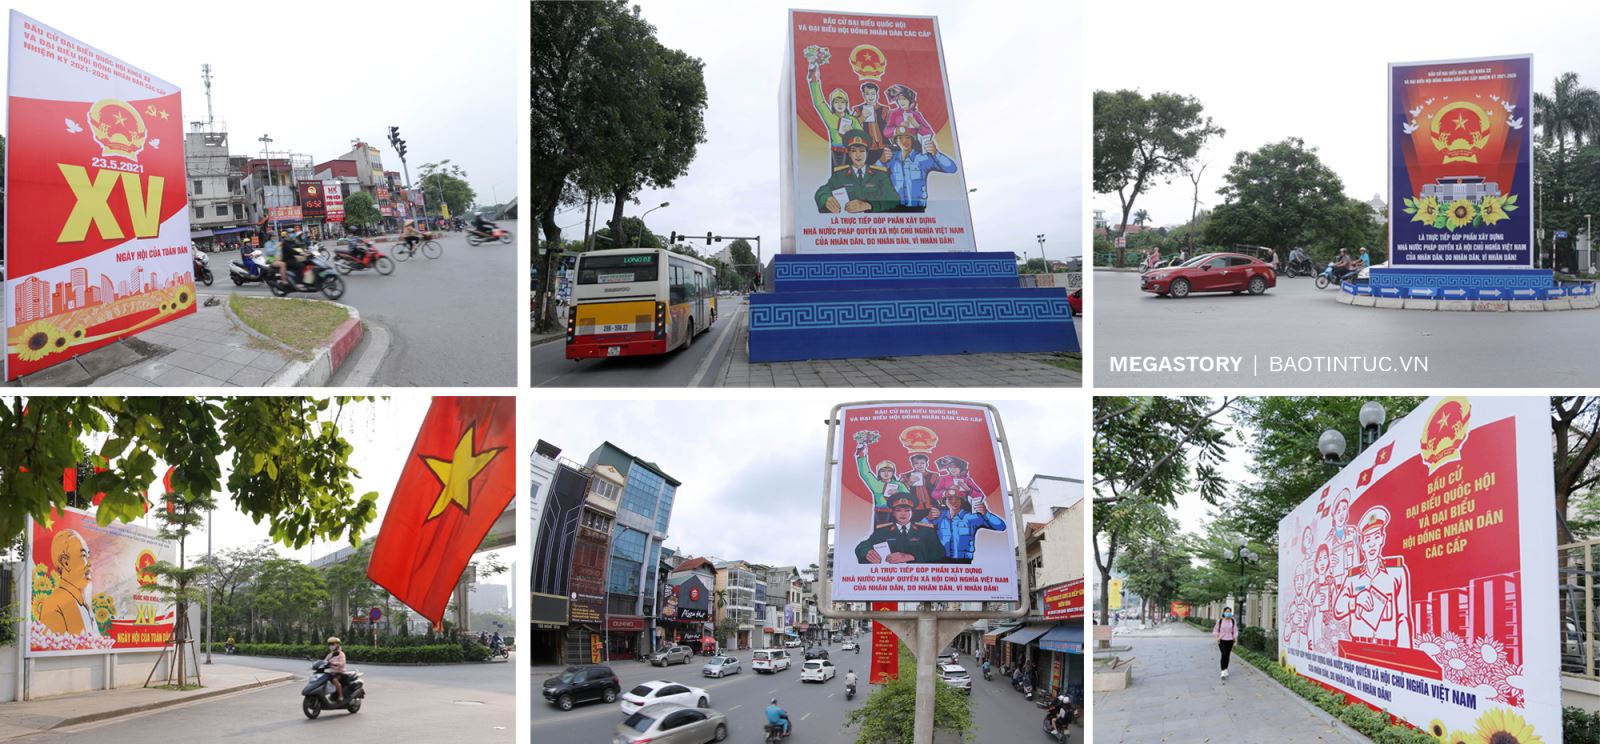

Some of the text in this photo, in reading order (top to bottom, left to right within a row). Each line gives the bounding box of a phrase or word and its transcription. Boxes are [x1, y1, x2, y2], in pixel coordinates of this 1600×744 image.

[92, 157, 143, 173] 23.5.2021
[56, 163, 165, 243] XV
[116, 250, 135, 262] NGÀY
[137, 249, 148, 261] HỘI
[149, 246, 161, 258] CỦA
[1427, 464, 1463, 494] BẦU CỬ
[1406, 472, 1496, 519] ĐẠI BIỂU QUỐC HỘI
[1419, 497, 1475, 528] VÀ ĐẠI BIỂU
[1403, 509, 1503, 550] HỘI ĐỒNG NHÂN DÂN
[1425, 535, 1467, 558] CÁC CẤP
[1378, 685, 1392, 702] DÂN!
[1392, 672, 1405, 688] CHỦ
[1406, 678, 1429, 696] NGHĨA
[1431, 684, 1450, 703] VIỆT
[1452, 690, 1476, 710] NAM
